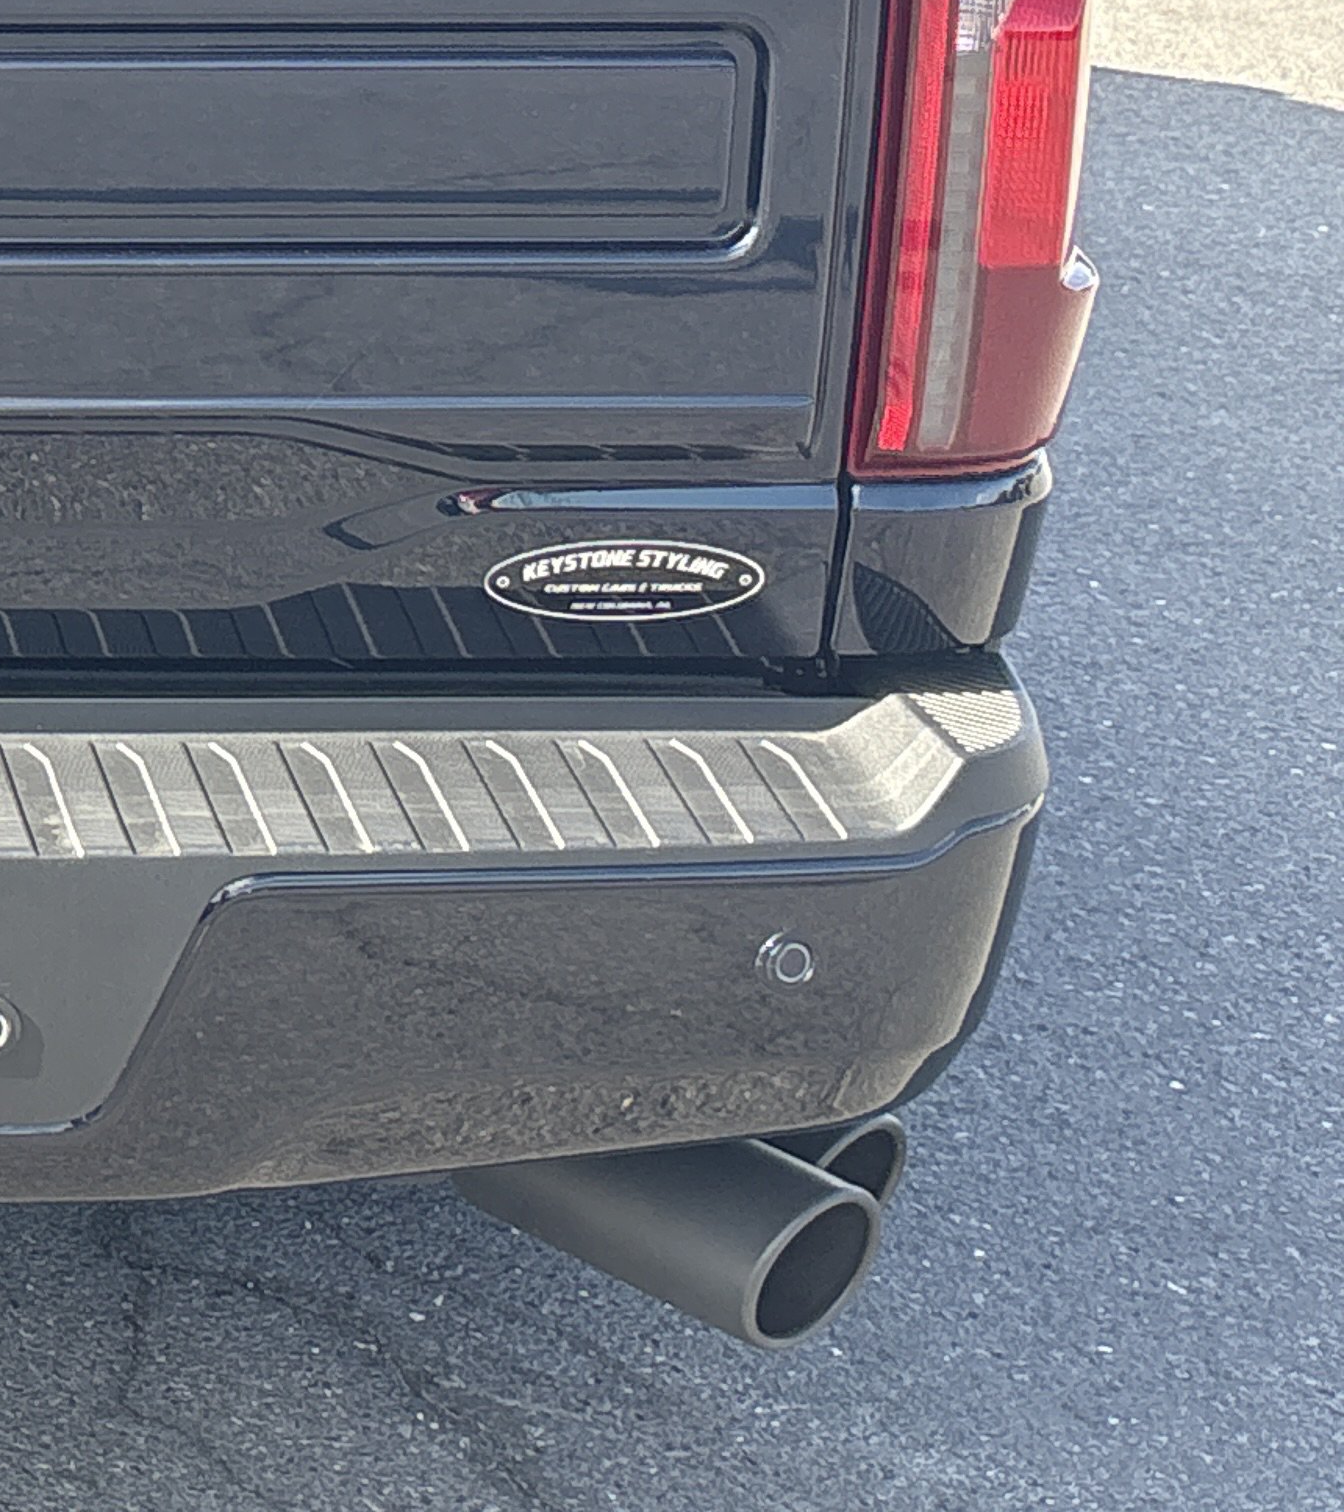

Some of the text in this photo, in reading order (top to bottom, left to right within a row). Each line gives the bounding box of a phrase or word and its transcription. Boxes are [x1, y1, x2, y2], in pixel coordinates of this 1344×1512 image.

[523, 549, 730, 582] KEYSTONE STYLING
[543, 582, 601, 594] CUSTOM
